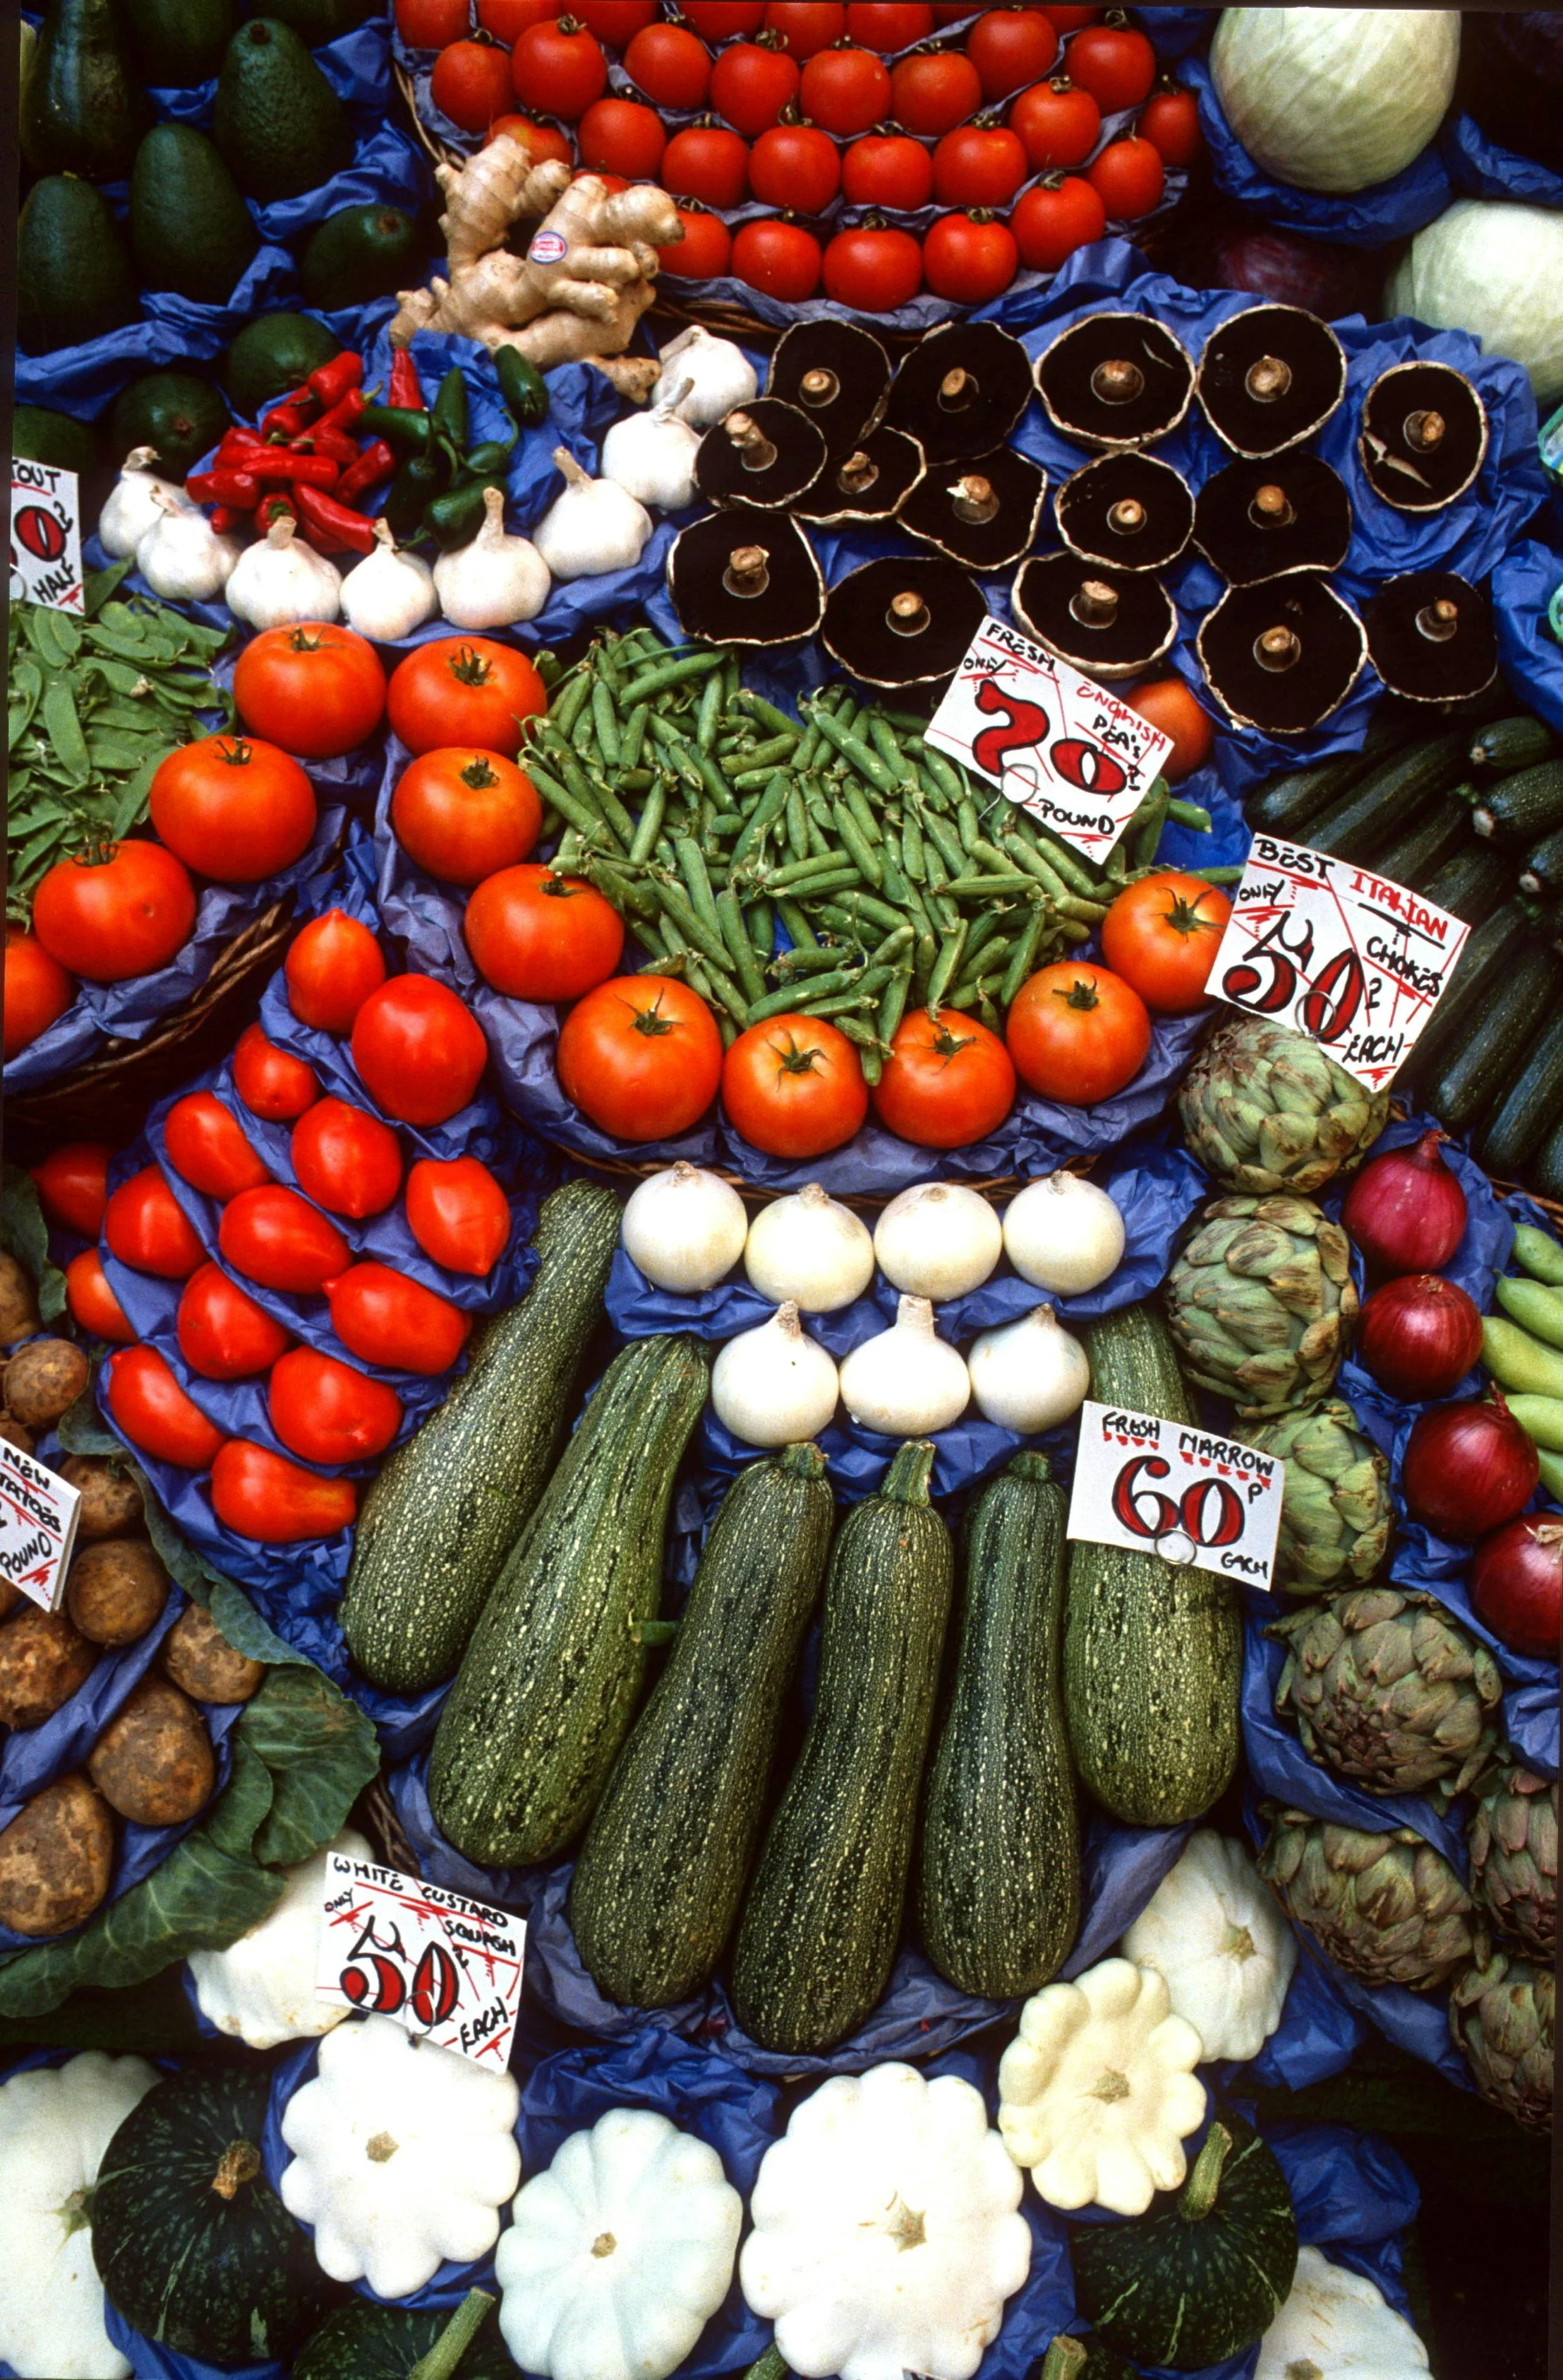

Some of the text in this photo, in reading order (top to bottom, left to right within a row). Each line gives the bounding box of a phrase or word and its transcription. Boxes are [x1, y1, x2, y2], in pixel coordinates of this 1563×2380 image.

[963, 656, 1007, 675] ONLY
[986, 623, 1055, 672] FRESH
[972, 679, 1127, 795] 20
[1038, 799, 1115, 835] POUND
[1239, 880, 1285, 906] ONLY
[1255, 839, 1449, 940] BEST ITALIAN
[1222, 911, 1365, 1042] 50
[1366, 936, 1443, 997] CHOKES
[1342, 1033, 1404, 1064] EACH
[1102, 1411, 1160, 1440] FRESH
[3, 1447, 50, 1490] NEW
[1112, 1455, 1263, 1547] 60 P
[0, 1531, 52, 1579] POUND
[324, 1888, 354, 1913] ONLY
[333, 1857, 509, 1928] WHITE CUSTARD
[443, 1920, 516, 1957] SQUASH
[339, 1915, 460, 2027] 50
[460, 1996, 510, 2054] EACH
